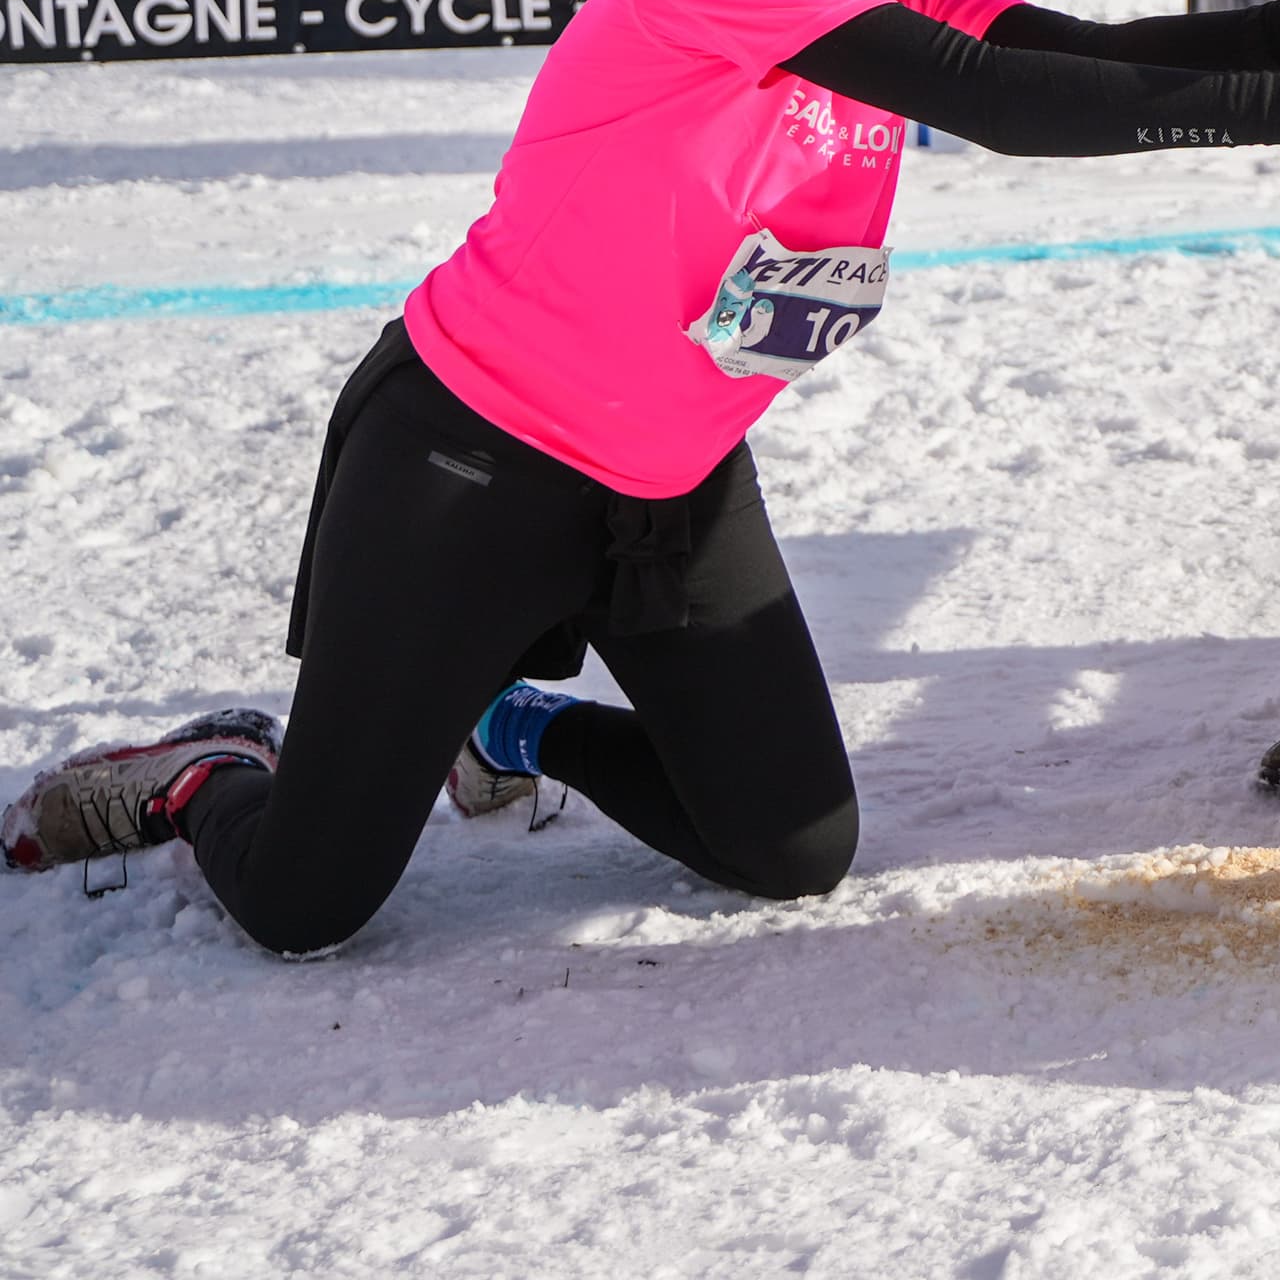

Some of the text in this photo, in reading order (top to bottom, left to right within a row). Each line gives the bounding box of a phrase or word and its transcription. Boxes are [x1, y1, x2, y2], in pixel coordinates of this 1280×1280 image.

[838, 127, 849, 140] &
[853, 123, 902, 154] LOI
[1136, 127, 1234, 144] KIPSTA
[742, 244, 887, 287] YETI RACE
